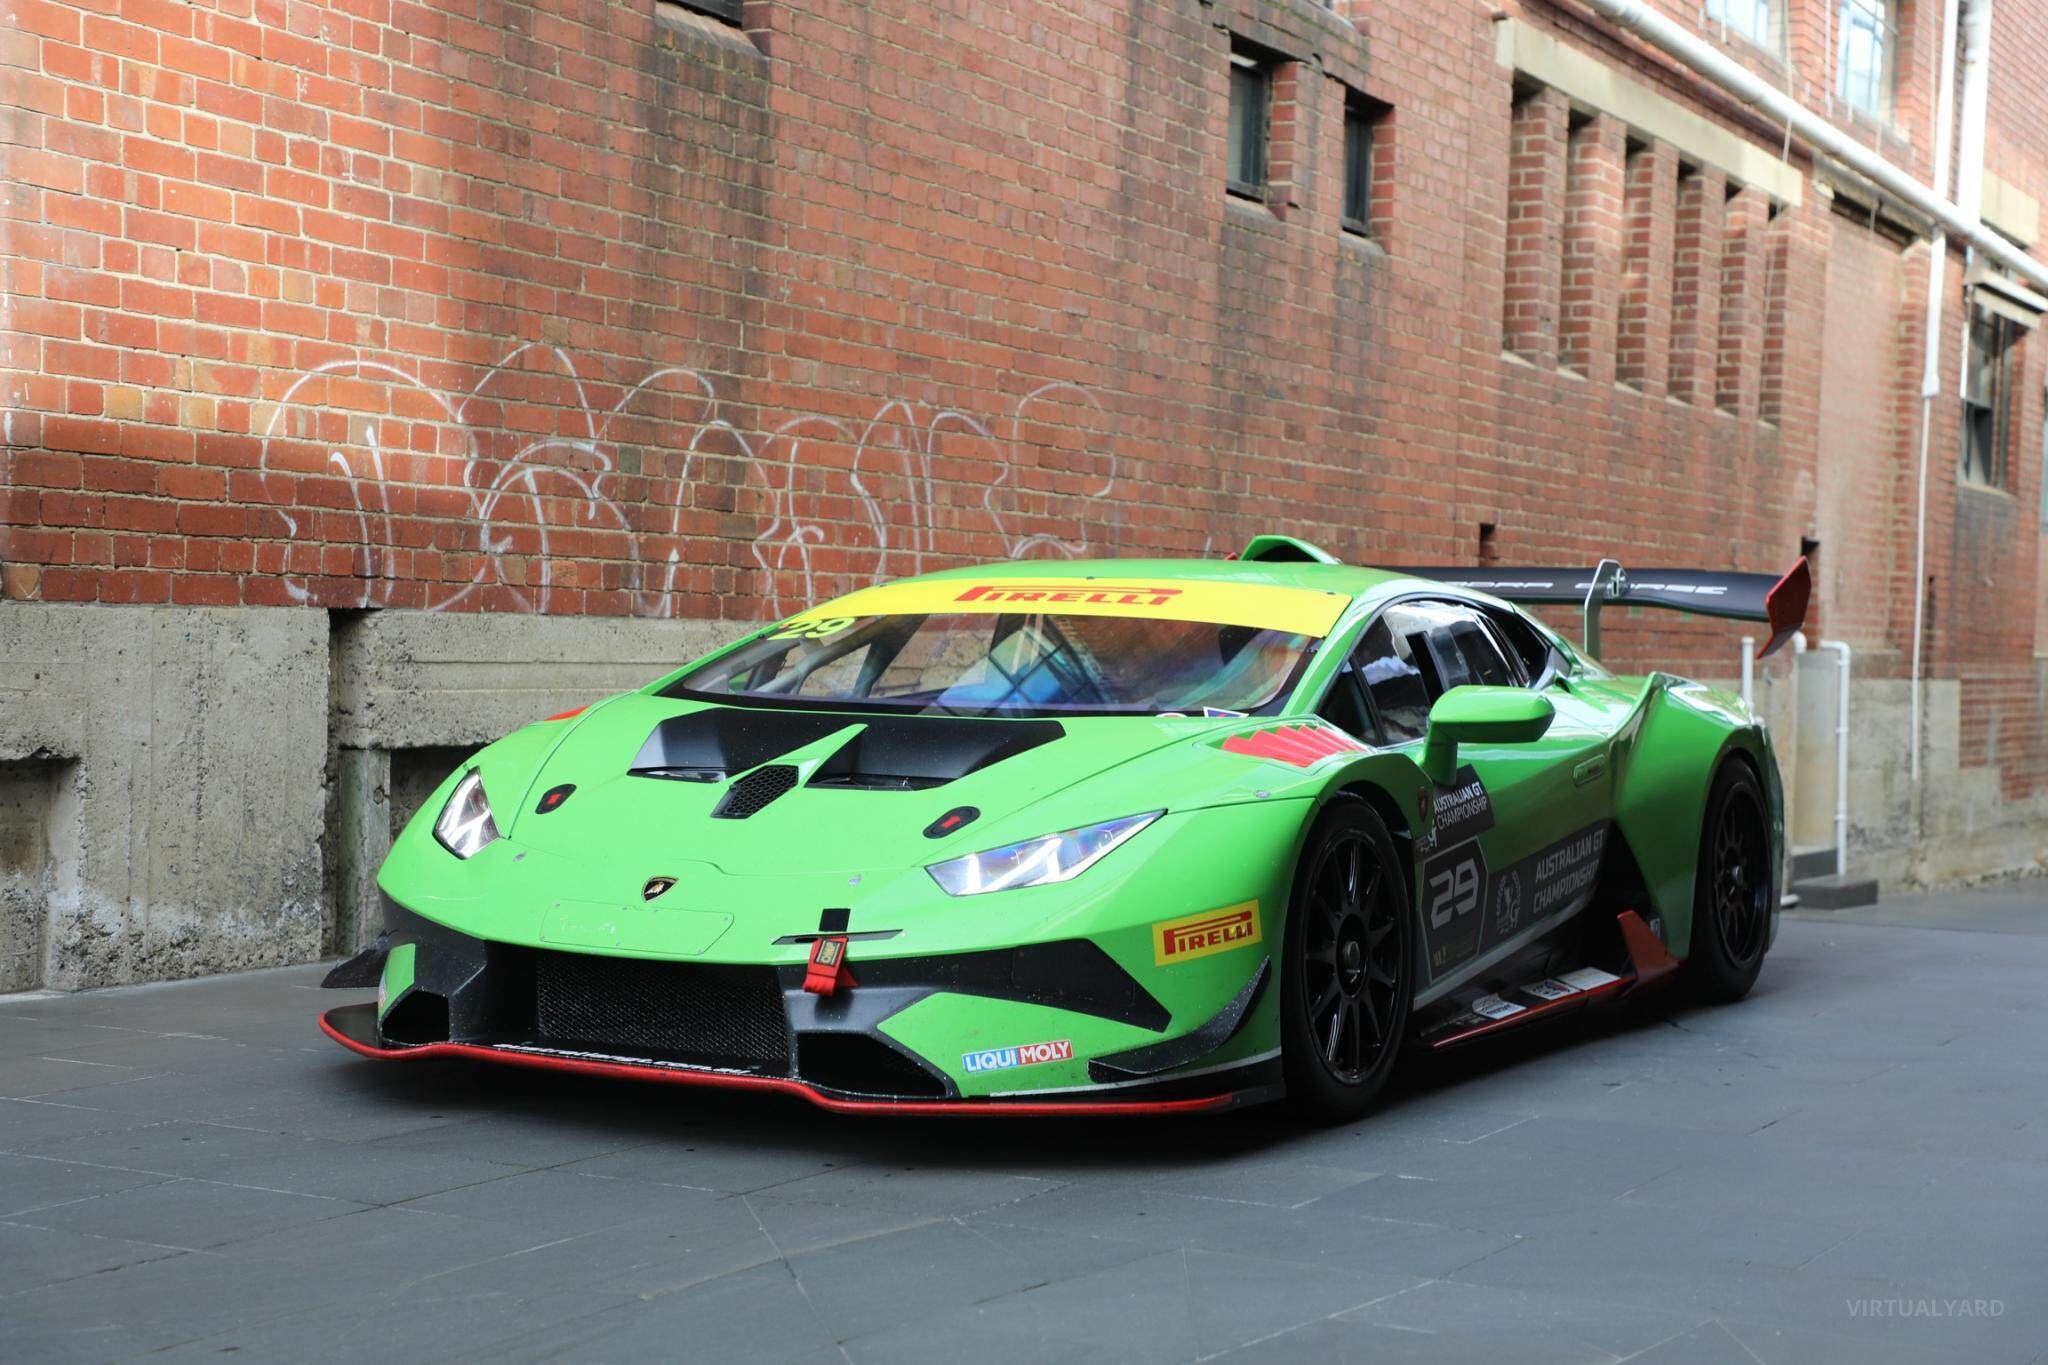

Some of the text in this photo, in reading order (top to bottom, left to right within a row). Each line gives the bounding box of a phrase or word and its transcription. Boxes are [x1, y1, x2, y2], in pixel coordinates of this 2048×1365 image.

[954, 585, 1183, 605] PIRELLI
[767, 617, 855, 640] 29
[1434, 781, 1484, 815] AUSTRALIAN GT
[1437, 796, 1488, 830] CHAMPIONSHIP
[1536, 829, 1605, 883] AUSTRALIAN GT
[1429, 858, 1480, 930] 29
[1163, 910, 1253, 956] PIRELLI
[965, 1041, 1070, 1073] LIQUI MOLY
